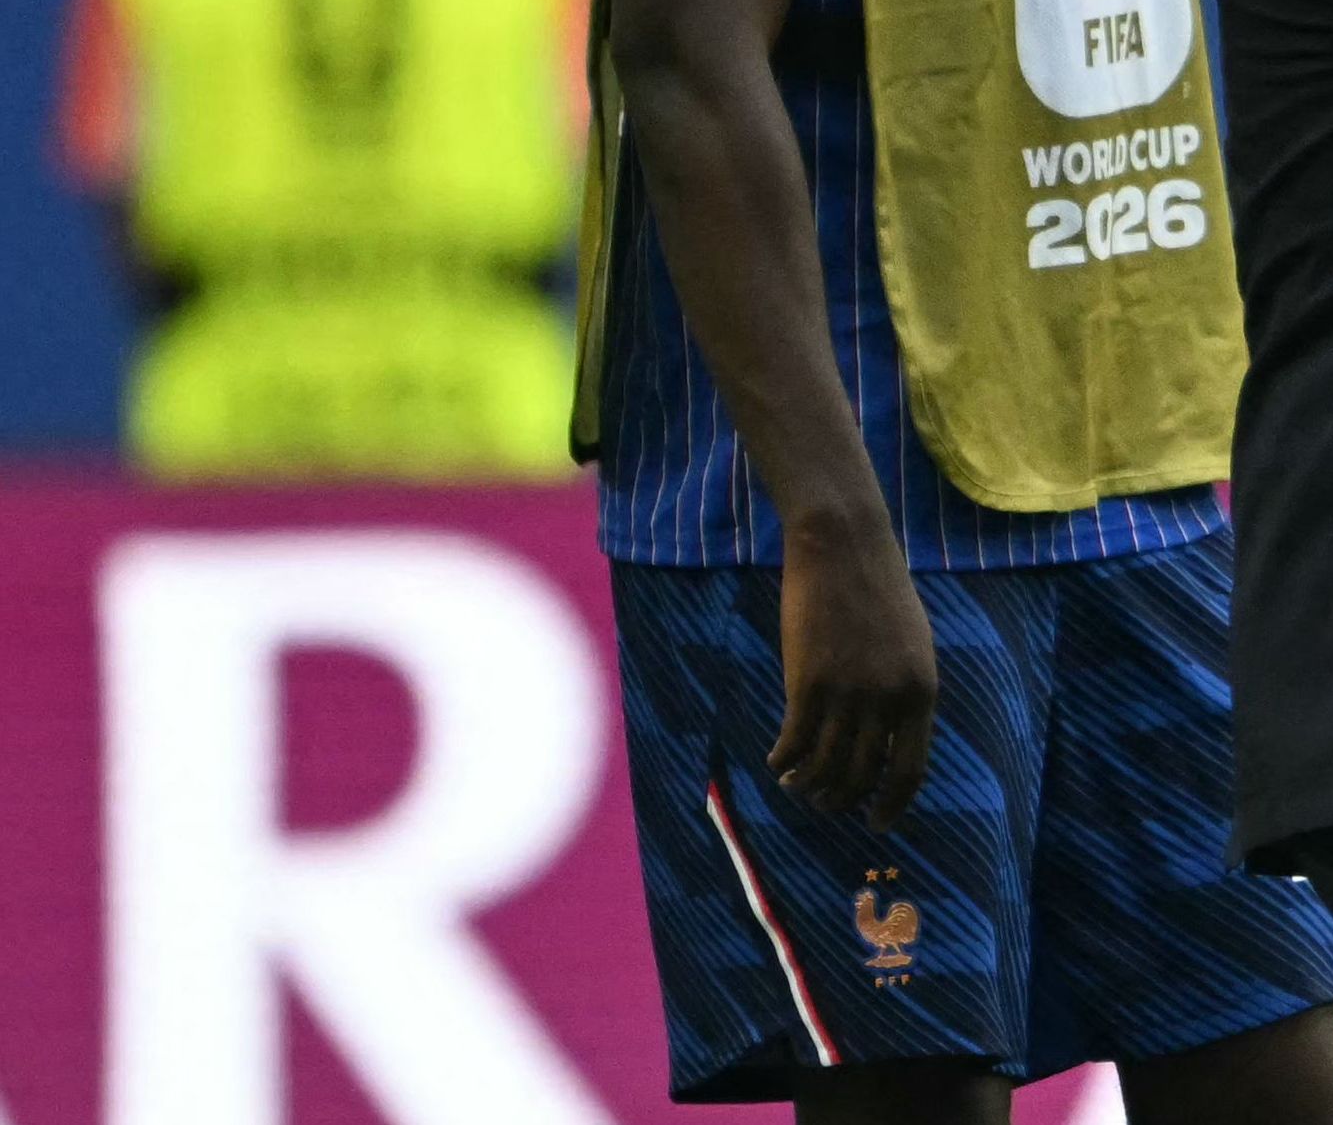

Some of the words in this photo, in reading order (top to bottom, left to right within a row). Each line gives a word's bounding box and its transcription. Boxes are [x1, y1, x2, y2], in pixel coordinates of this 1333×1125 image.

[1083, 11, 1144, 68] FIFA
[1022, 134, 1128, 188] WORLD
[1129, 124, 1200, 172] CUP
[1026, 179, 1206, 269] 2026
